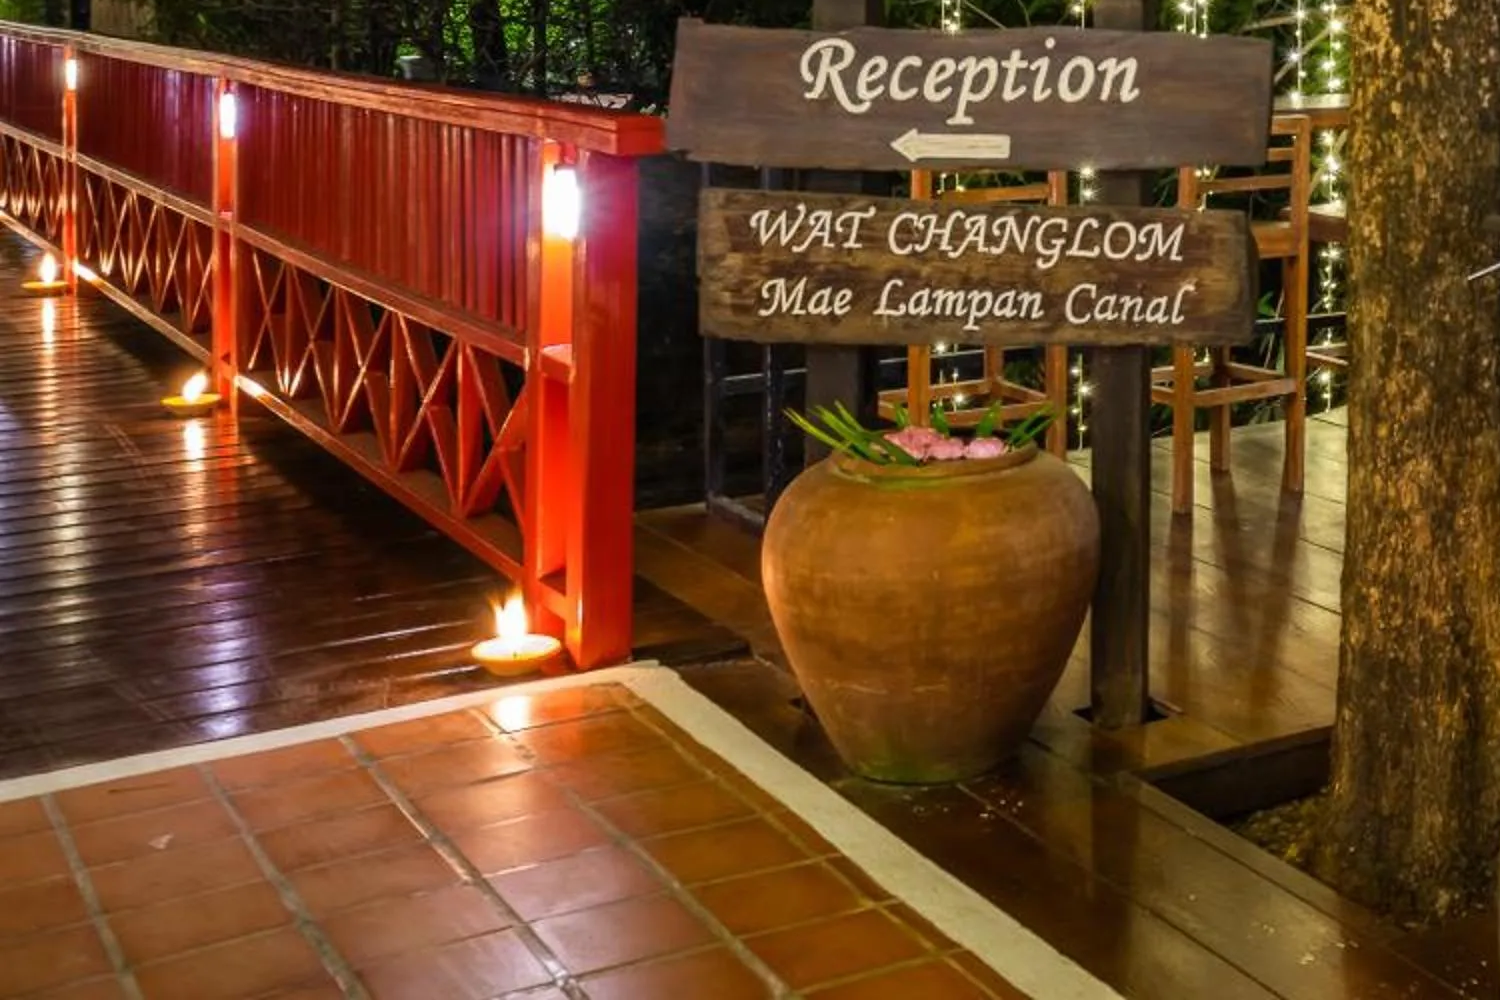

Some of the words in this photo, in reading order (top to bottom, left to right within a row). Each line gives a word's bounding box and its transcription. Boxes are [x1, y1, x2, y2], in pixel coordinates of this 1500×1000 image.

[800, 37, 1140, 125] Reception
[749, 203, 876, 253] WAT
[888, 211, 1184, 269] CHANGLOM
[759, 277, 852, 316] Mae
[873, 279, 1044, 331] Lampan
[1065, 283, 1195, 324] Canal
